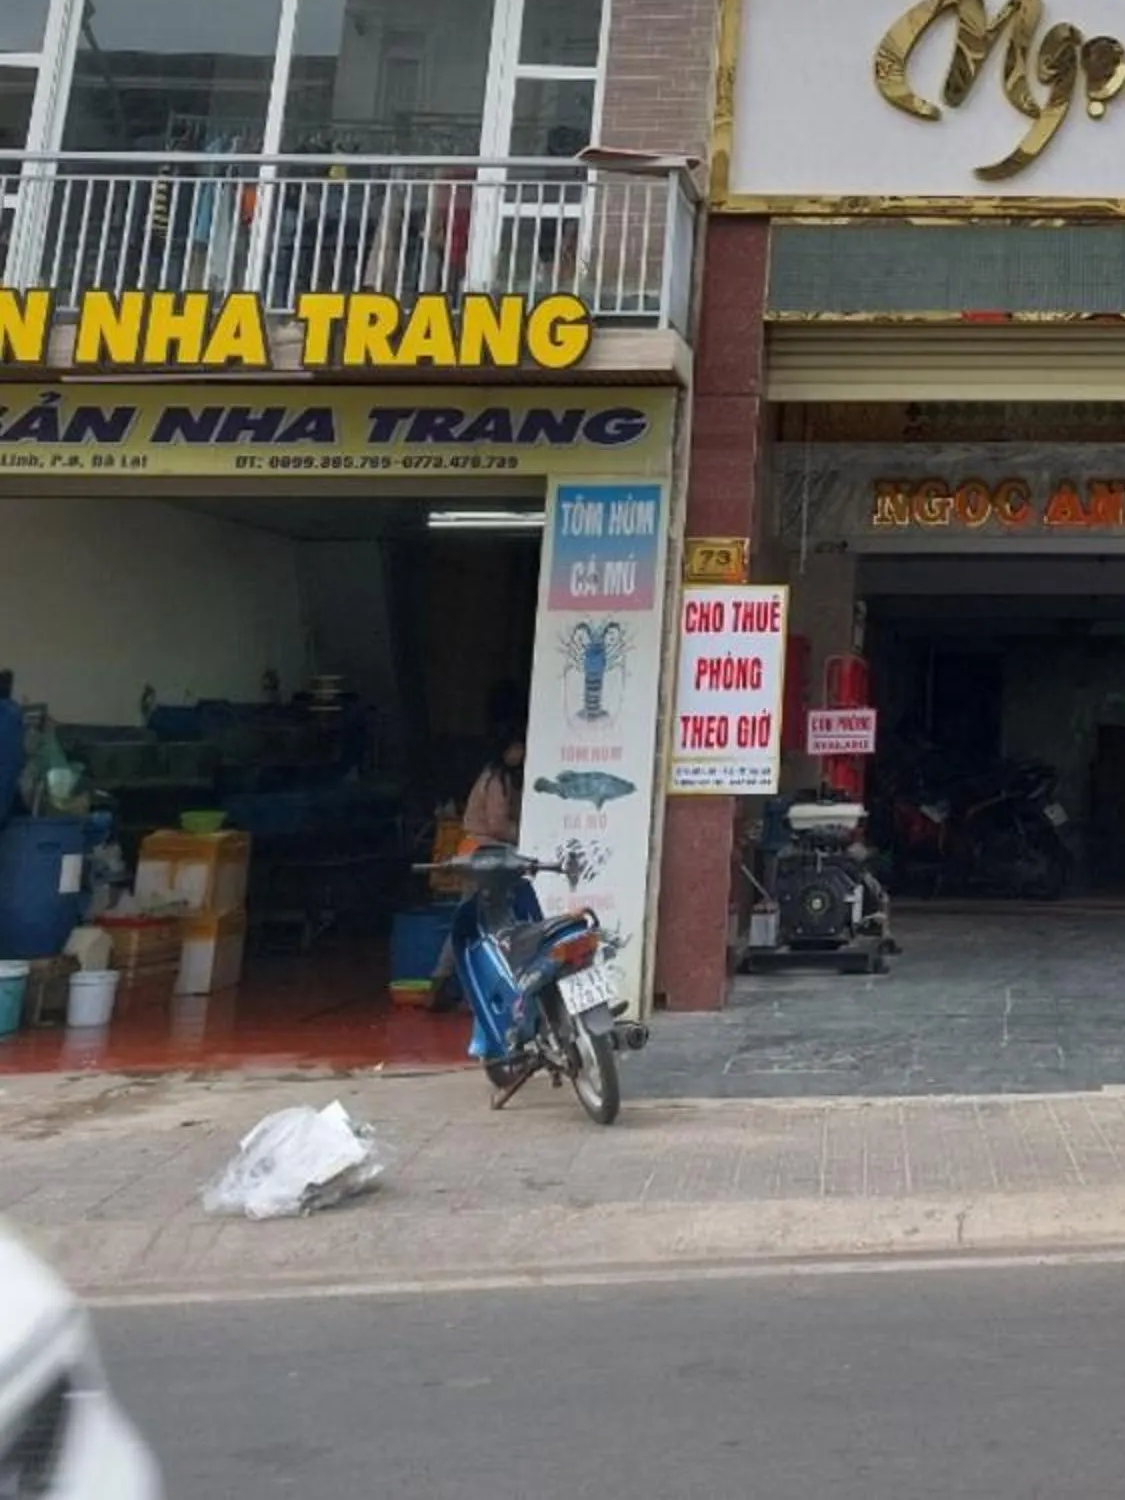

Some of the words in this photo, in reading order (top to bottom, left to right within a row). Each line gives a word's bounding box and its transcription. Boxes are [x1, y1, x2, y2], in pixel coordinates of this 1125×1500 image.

[75, 291, 267, 364] NHA
[298, 293, 591, 368] TRANG
[0, 390, 136, 443] ẢN
[151, 406, 336, 443] NHA
[368, 406, 648, 445] TRANG
[562, 493, 603, 536] TÔM
[608, 492, 655, 536] HÙM
[570, 553, 598, 596] CÁ
[603, 553, 637, 595] MÚ
[699, 549, 731, 571] 73
[685, 601, 725, 633] CHO
[732, 594, 781, 633] THUÊ
[695, 651, 762, 690] PHÒNG
[680, 715, 728, 749] THEO
[737, 708, 772, 748] GIỜ
